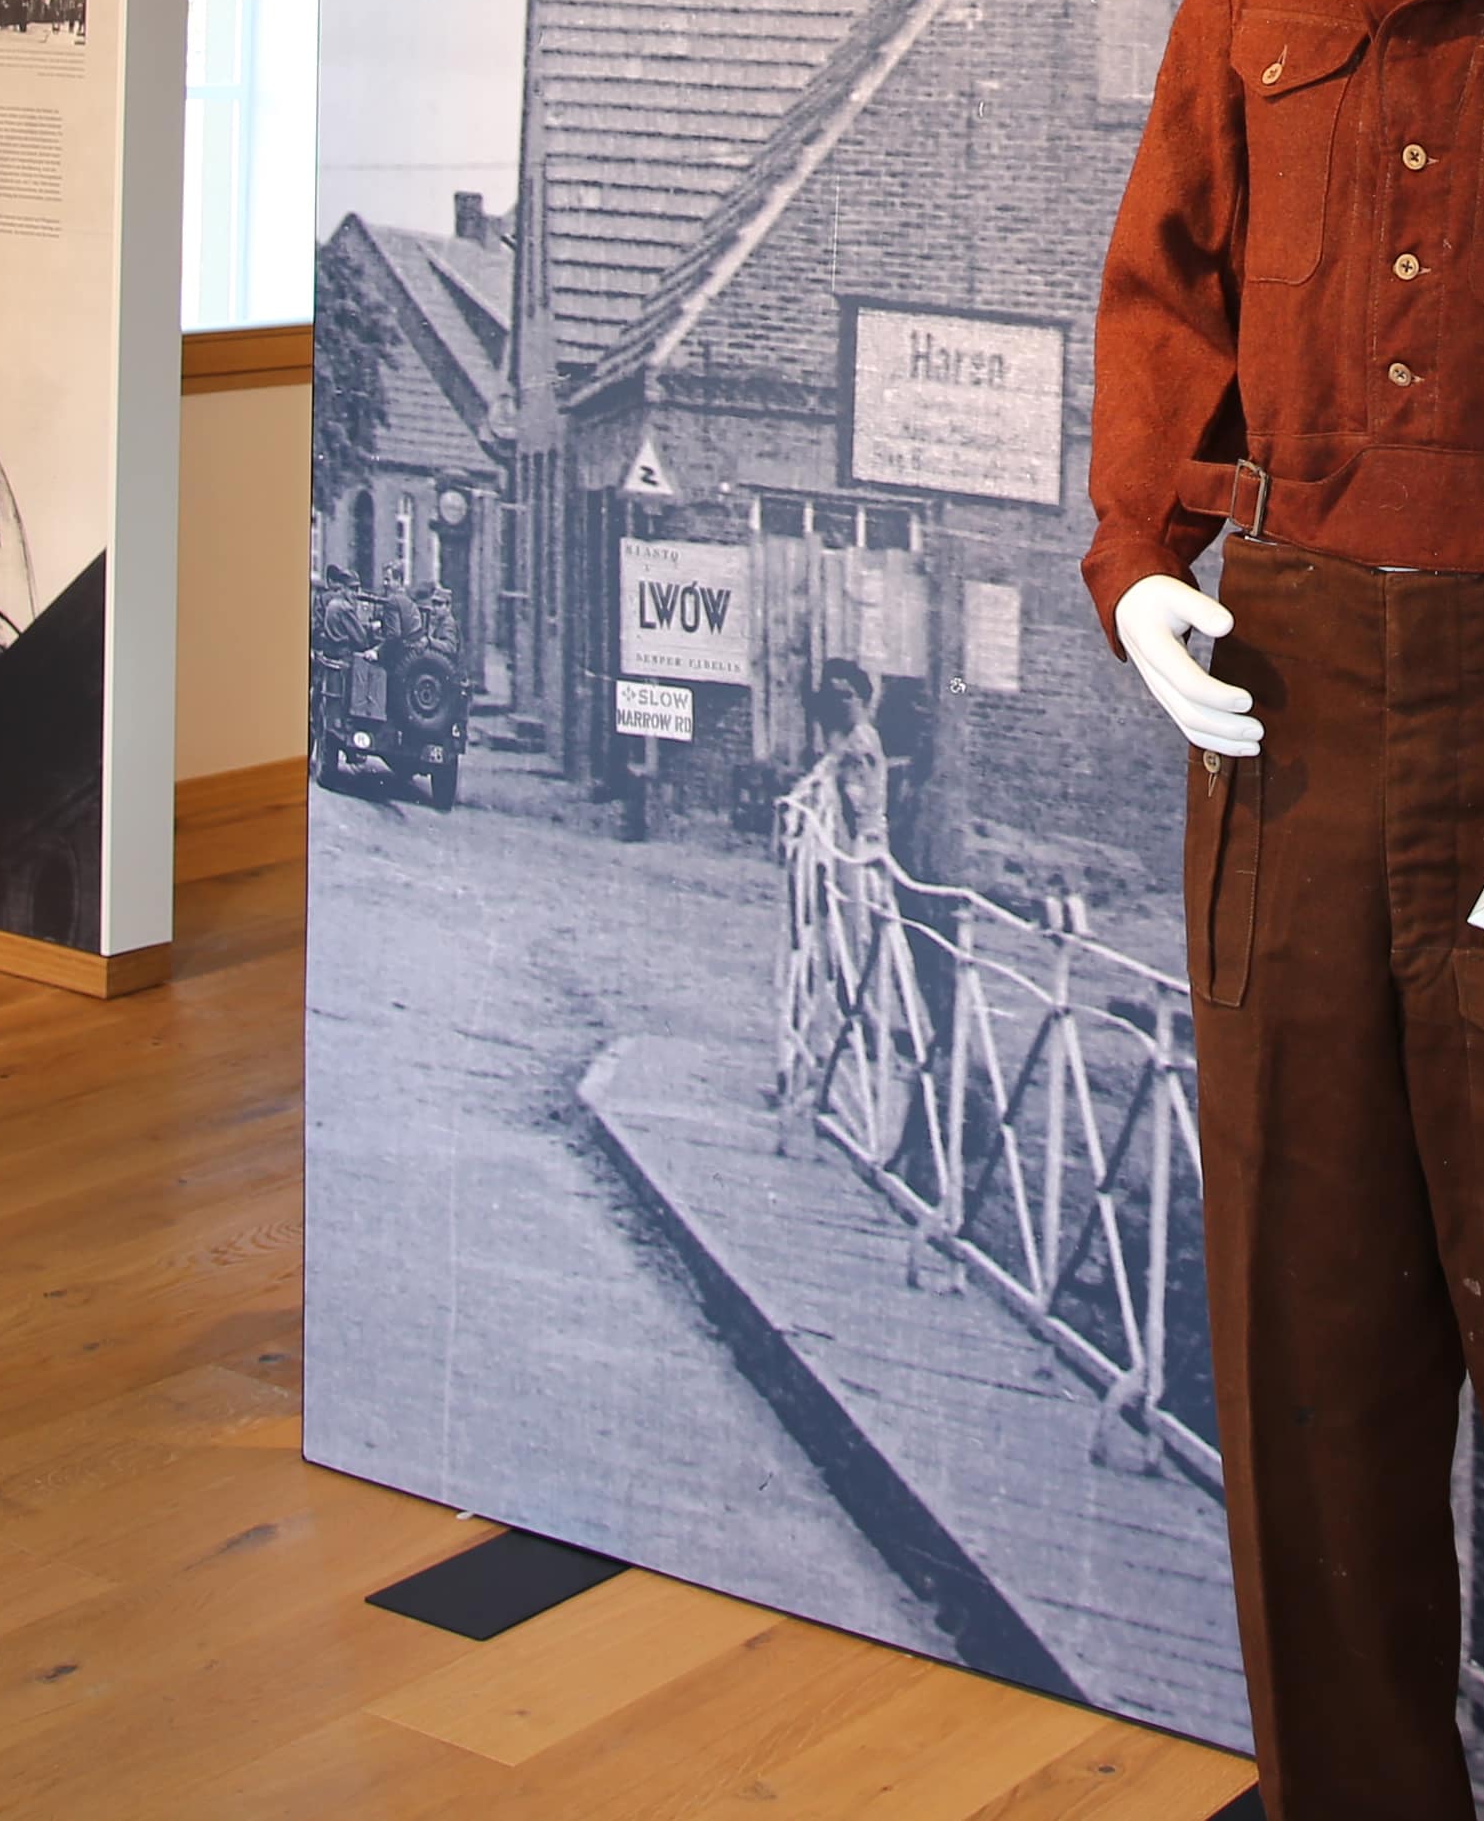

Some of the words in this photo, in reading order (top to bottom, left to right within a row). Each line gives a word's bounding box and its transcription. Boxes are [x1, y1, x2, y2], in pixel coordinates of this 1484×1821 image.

[910, 329, 1003, 386] Haren
[639, 581, 731, 634] LWÓW
[638, 689, 688, 709] SLOW
[618, 708, 671, 731] NARROW
[675, 715, 691, 735] RD
